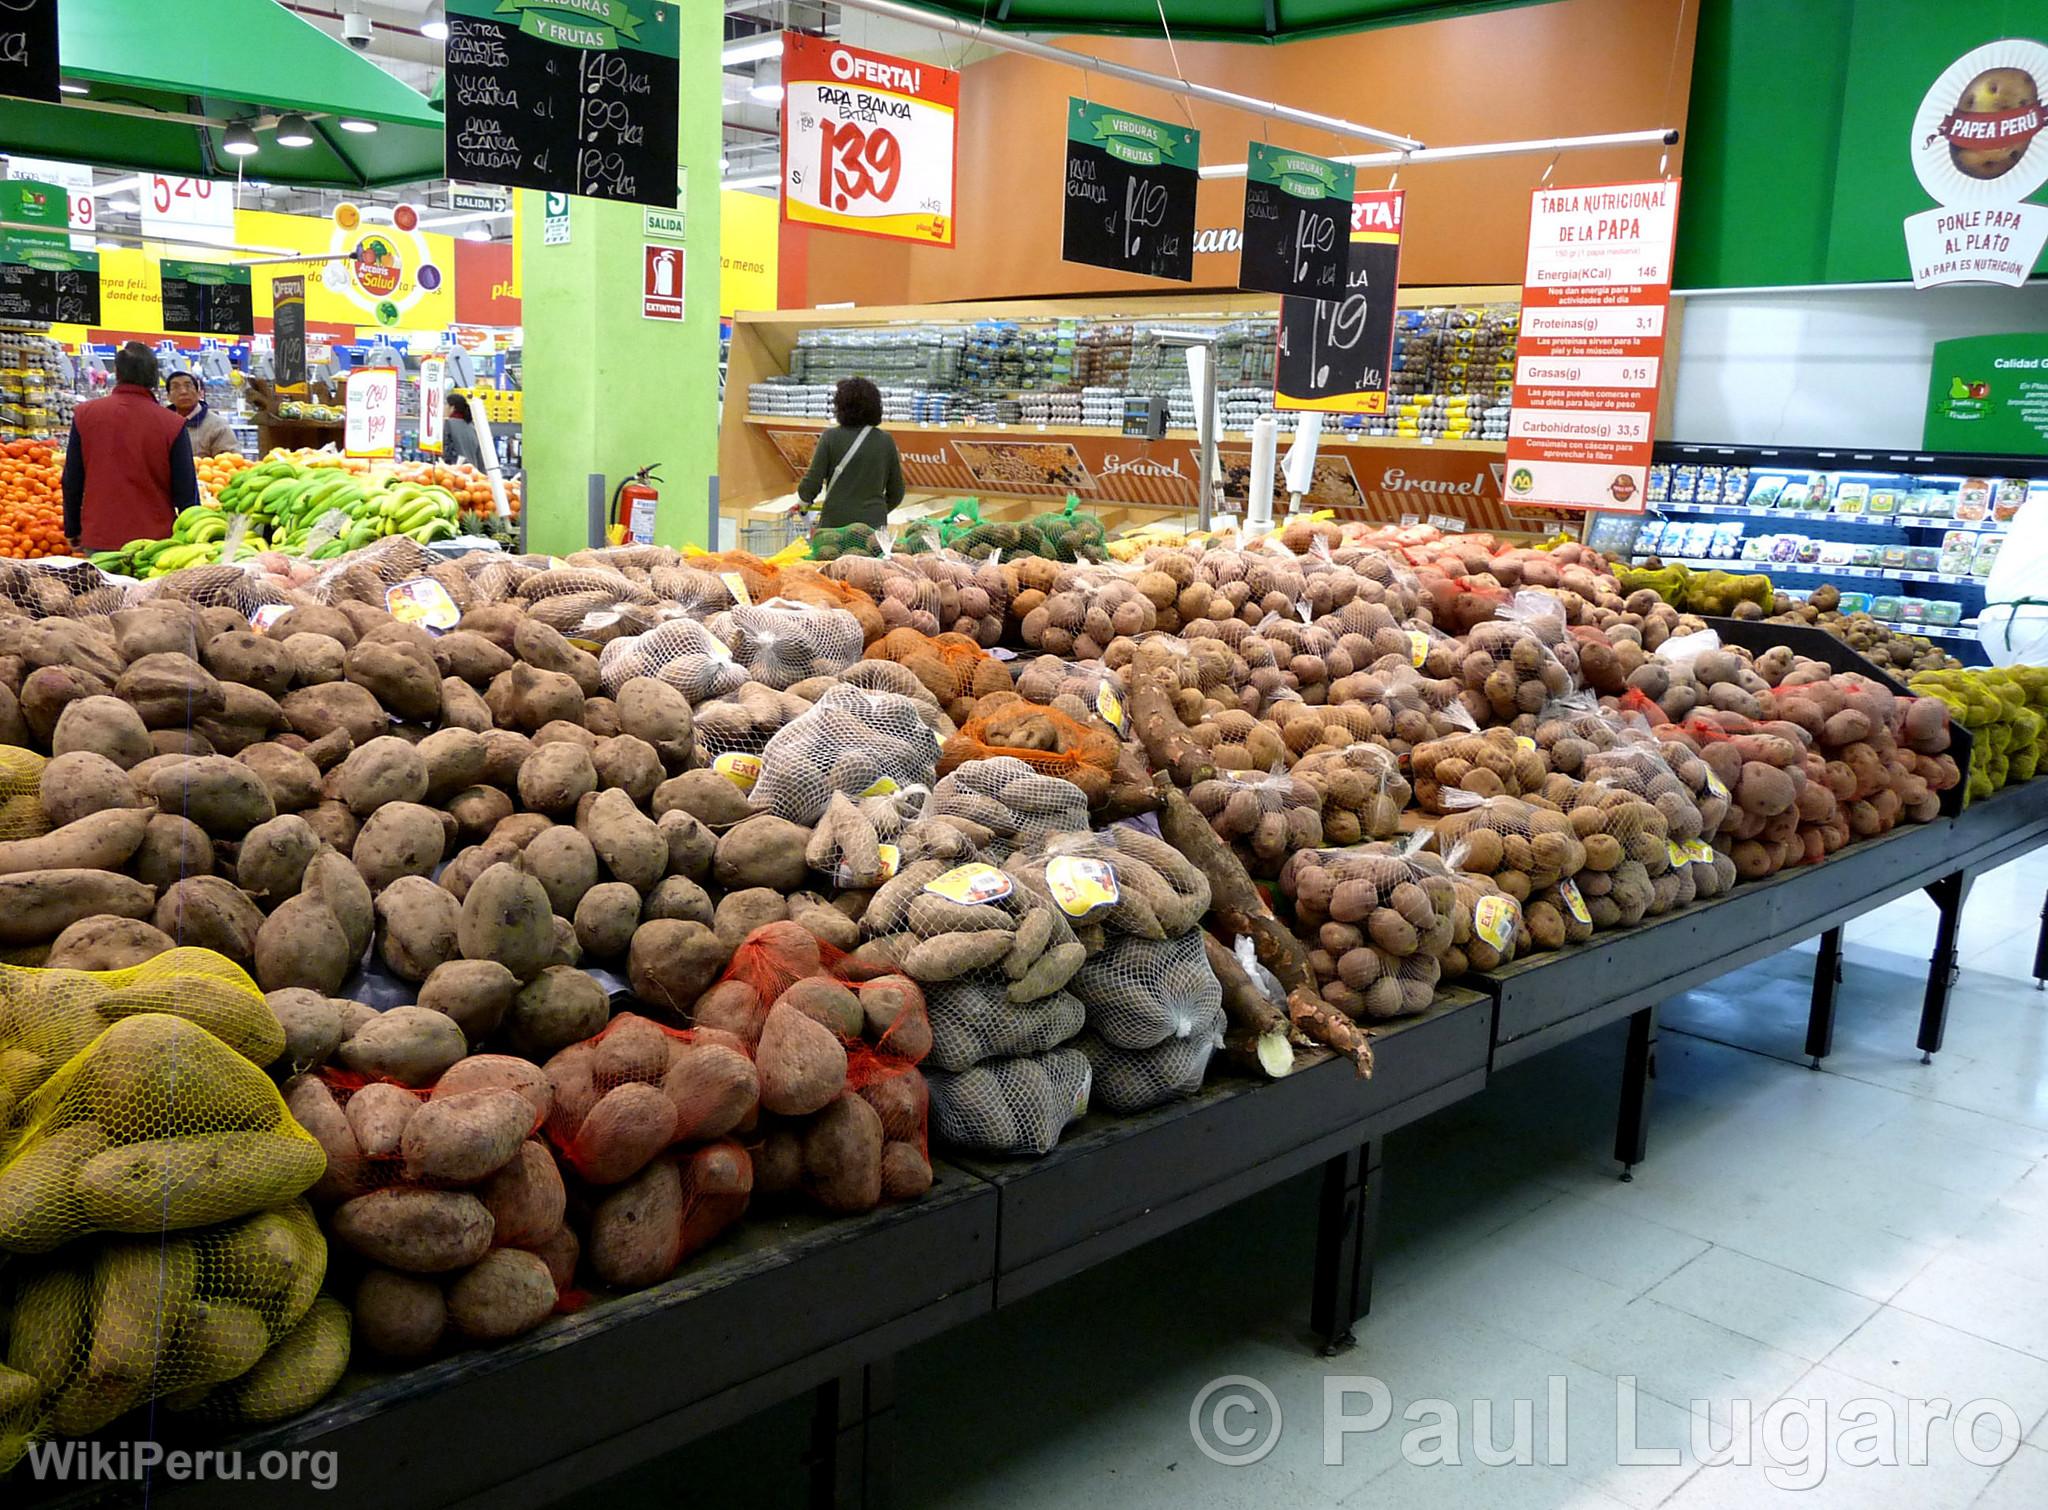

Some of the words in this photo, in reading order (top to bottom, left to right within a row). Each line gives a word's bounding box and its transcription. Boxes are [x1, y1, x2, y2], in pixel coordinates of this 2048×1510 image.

[451, 20, 506, 39] EXTRA
[536, 20, 546, 33] Y
[550, 25, 604, 46] FRUTAS
[830, 50, 921, 94] OFERTA!
[457, 90, 519, 109] BLANCA
[818, 86, 851, 107] PAPA
[858, 94, 912, 120] BLANCA
[839, 106, 878, 125] EXTRA
[1950, 119, 1996, 139] PAPEA
[2000, 110, 2038, 136] PERÚ
[465, 116, 502, 135] PAPA
[1112, 119, 1158, 141] VERDURAS
[457, 132, 520, 151] BLANCA
[1115, 144, 1121, 154] Y
[1122, 146, 1153, 162] FRUTAS
[1287, 159, 1324, 177] VERDURAS
[1068, 180, 1108, 204] BLANCA
[1288, 182, 1294, 190] Y
[1294, 182, 1320, 196] FRUTAS
[455, 196, 491, 209] SALIDA
[1541, 197, 1579, 213] TABLA
[1584, 191, 1666, 214] NUTRICIONAL
[1351, 196, 1402, 230] RTA!
[1937, 211, 1981, 234] PONLE
[1985, 210, 2022, 231] PAPA
[648, 215, 683, 232] SALIDA
[1559, 226, 1575, 242] DE
[1579, 225, 1593, 241] LA
[1598, 218, 1640, 241] PAPA
[1945, 239, 1961, 254] AL
[1966, 233, 2010, 253] PLATO
[732, 259, 765, 274] menos
[1637, 266, 1657, 278] 146
[1919, 266, 1930, 280] LA
[1933, 261, 1957, 275] PAPA
[1960, 259, 1972, 271] ES
[1974, 257, 2024, 278] NUTRICIÓN
[363, 273, 396, 290] Salud
[1548, 286, 1564, 295] Nos
[1565, 286, 1580, 295] dan
[1610, 285, 1629, 296] para
[1630, 284, 1642, 294] las
[106, 290, 138, 301] donde
[1558, 296, 1602, 305] actividades
[1603, 295, 1616, 304] del
[646, 303, 682, 315] EXTINTOR
[1636, 317, 1653, 330] 3,1
[1537, 337, 1551, 345] Las
[1588, 337, 1613, 345] sirven
[1613, 337, 1632, 347] para
[1632, 337, 1641, 345] la
[1551, 346, 1566, 356] piel
[1566, 348, 1573, 356] y
[1573, 346, 1585, 355] los
[1994, 358, 2039, 369] Calidad
[1528, 367, 1581, 381] Grasas(g)
[1622, 368, 1646, 381] 0,15
[1528, 388, 1542, 397] Las
[1542, 389, 1565, 398] papas
[1566, 389, 1595, 398] pueden
[1596, 390, 1630, 399] comerse
[1630, 391, 1641, 399] en
[1545, 398, 1565, 406] dieta
[1565, 399, 1583, 408] para
[1583, 399, 1603, 409] bajar
[1604, 400, 1615, 408] de
[1615, 400, 1636, 410] peso
[1522, 421, 1611, 437] Carbohidratos(g)
[1616, 424, 1640, 436] 33,5
[1543, 450, 1586, 459] aprovechar
[1586, 450, 1594, 459] la
[1595, 451, 1614, 460] fibra
[1568, 440, 1584, 449] con
[1615, 443, 1633, 452] para
[899, 447, 949, 465] ranel
[1104, 453, 1181, 478] Granel
[1380, 468, 1485, 497] Granel
